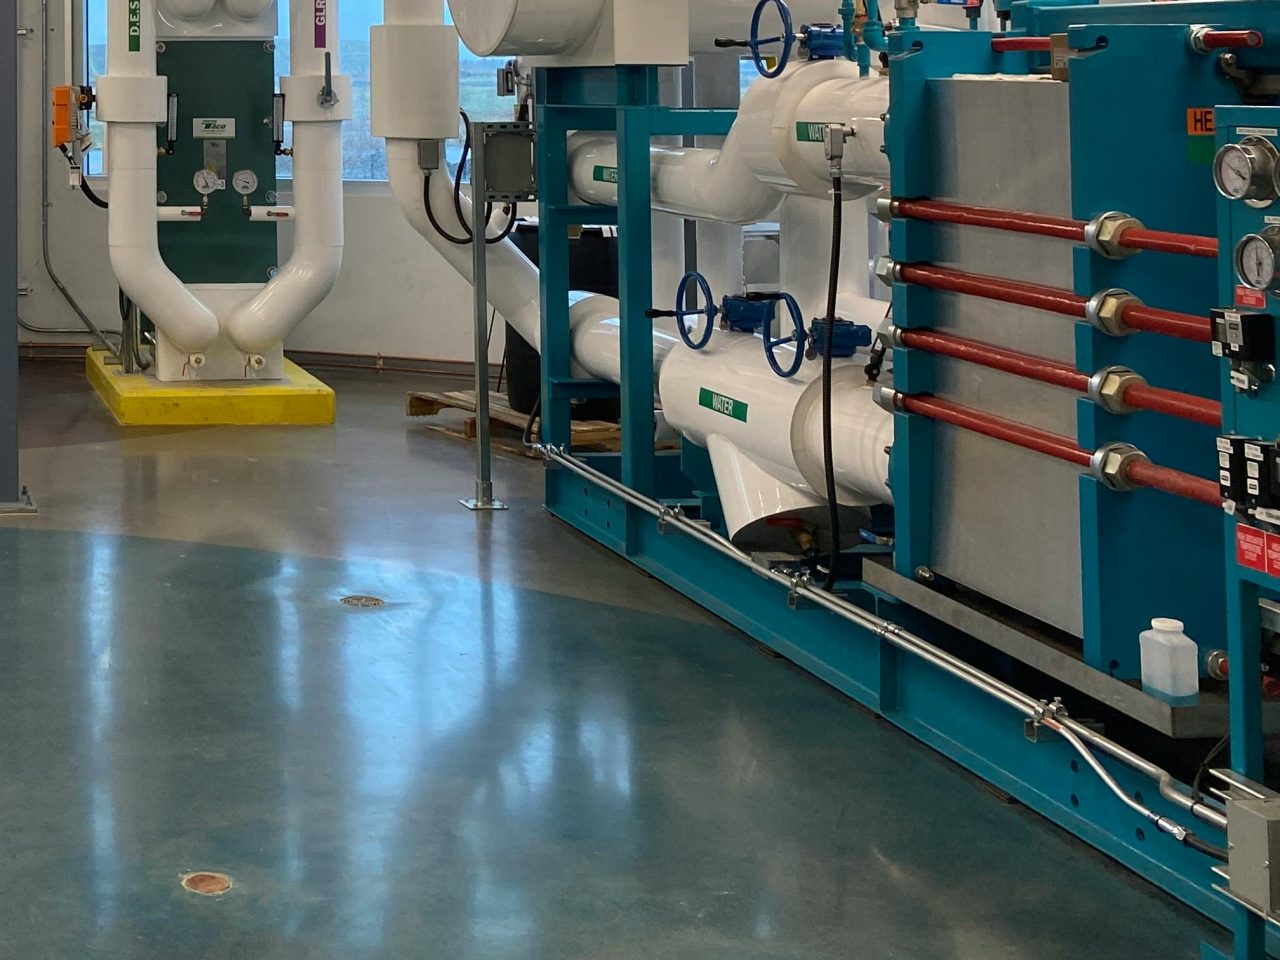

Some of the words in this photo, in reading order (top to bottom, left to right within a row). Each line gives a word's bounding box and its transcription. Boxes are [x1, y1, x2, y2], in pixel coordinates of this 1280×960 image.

[316, 0, 326, 26] GLR
[807, 123, 825, 141] WAT
[1194, 109, 1216, 133] HE
[712, 392, 734, 417] WATER
